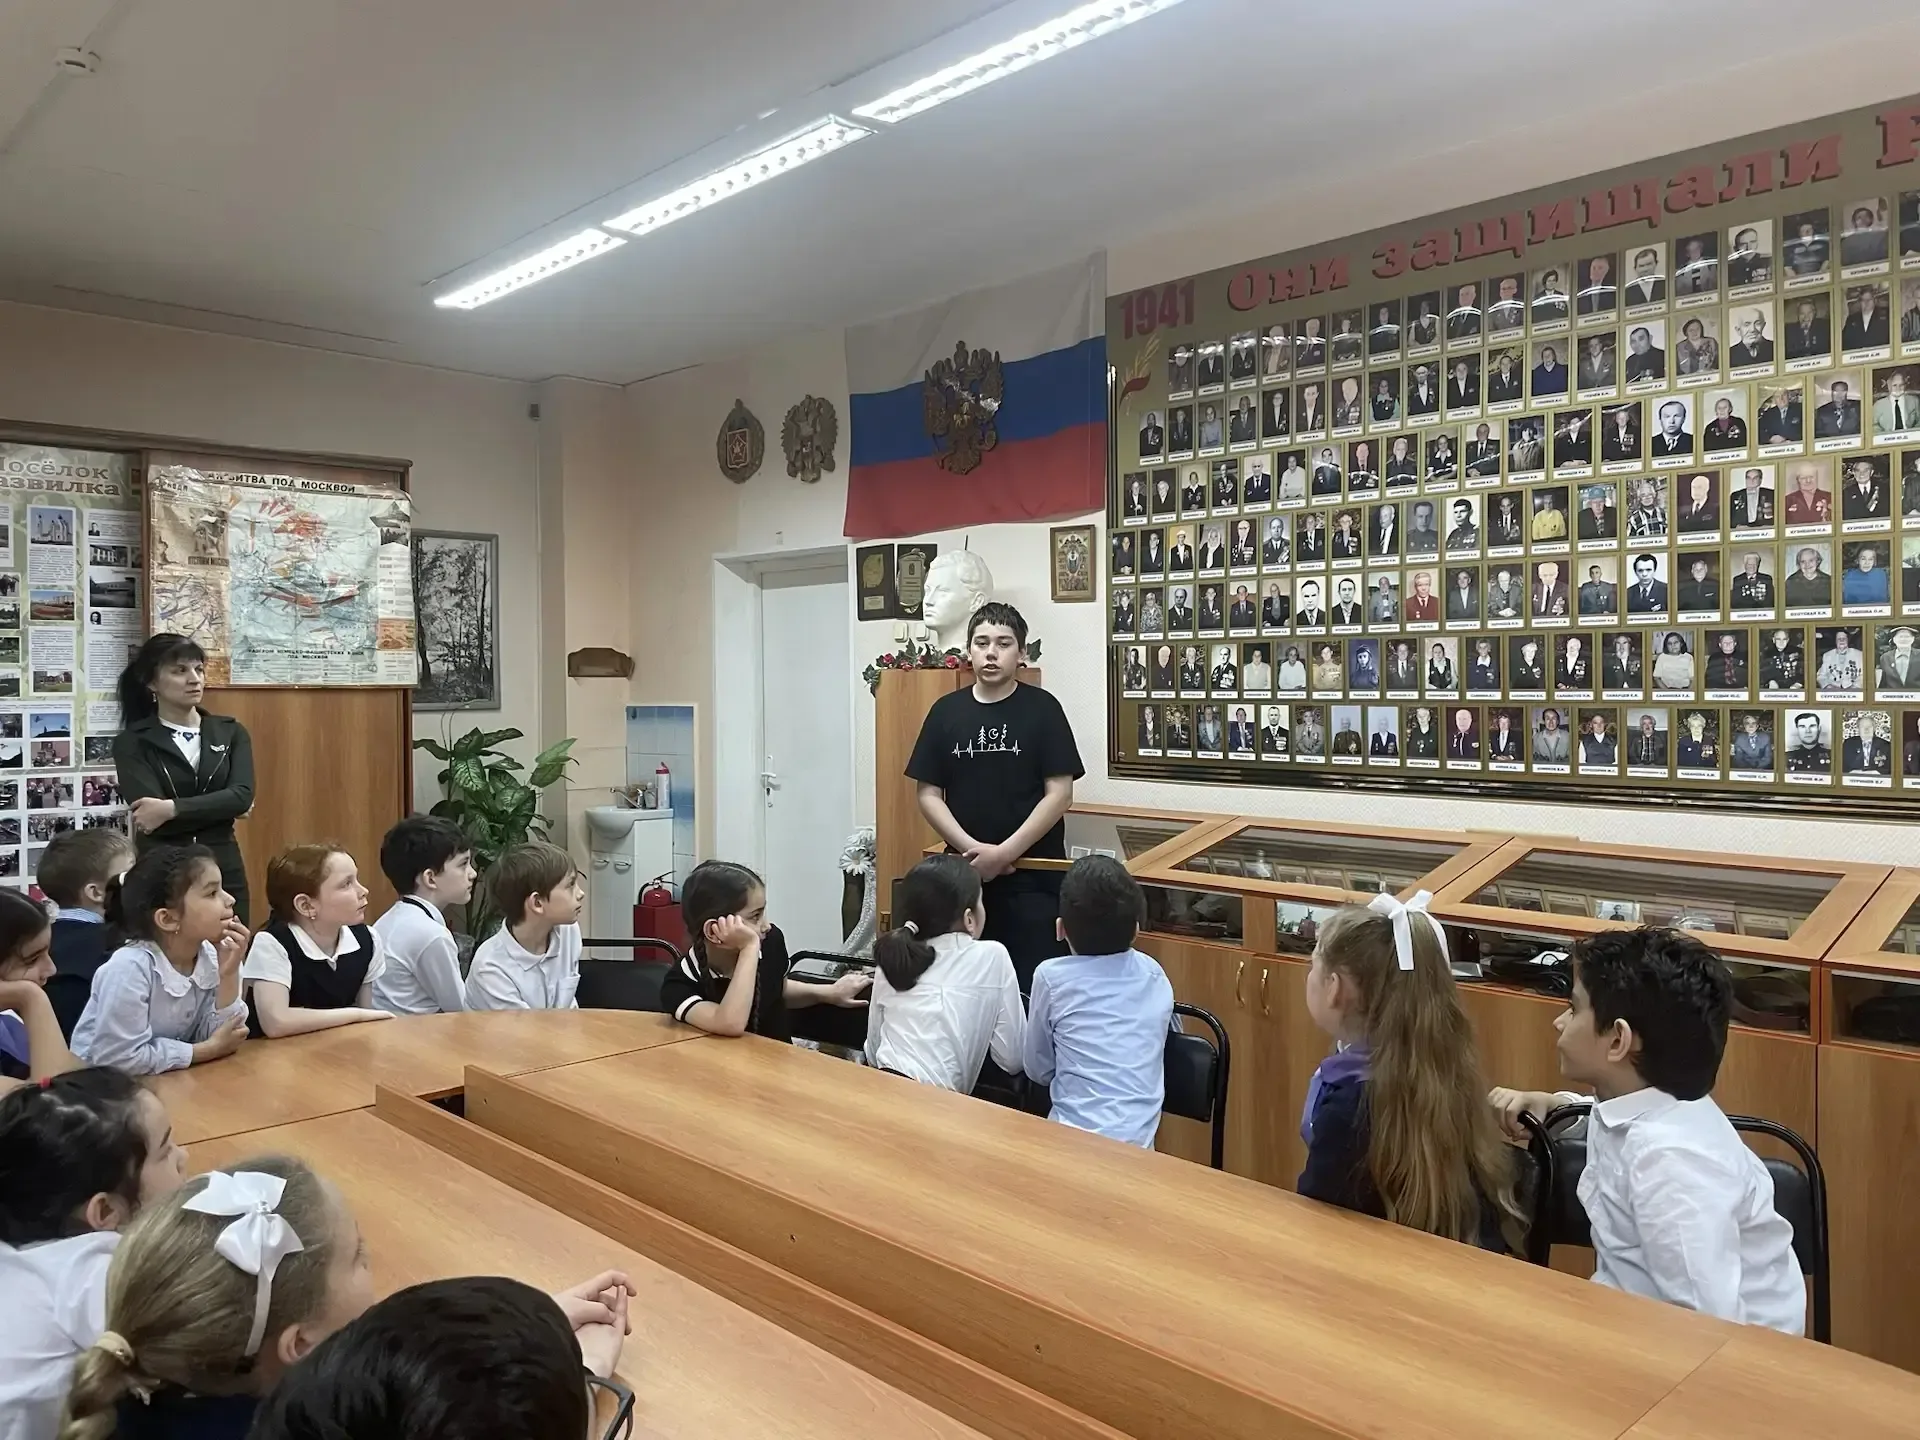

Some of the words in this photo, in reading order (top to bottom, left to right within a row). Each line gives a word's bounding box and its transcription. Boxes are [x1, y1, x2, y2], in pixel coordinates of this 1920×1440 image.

[1227, 255, 1349, 311] Они
[1371, 134, 1843, 279] защищали
[1876, 105, 1920, 169] Р
[1119, 278, 1195, 340] 1941
[0, 476, 120, 495] азвилка
